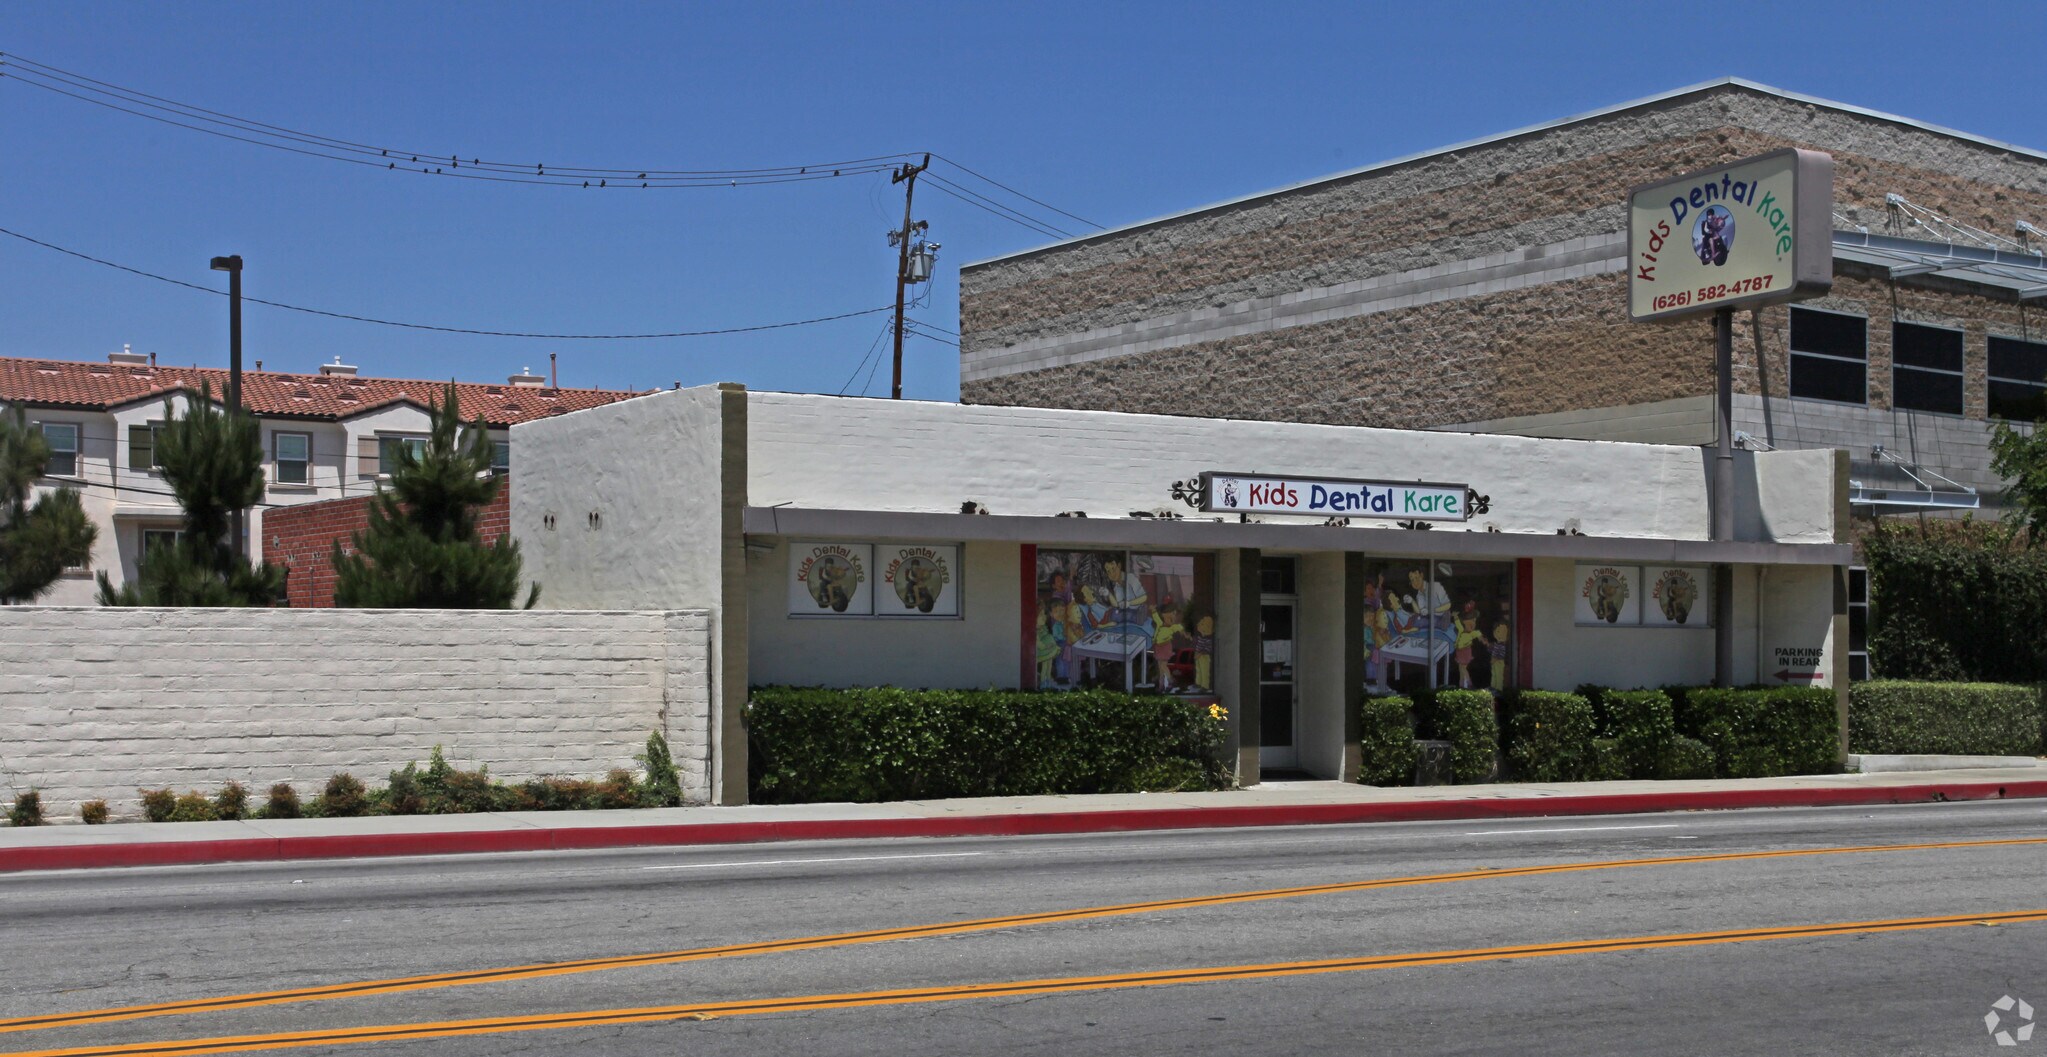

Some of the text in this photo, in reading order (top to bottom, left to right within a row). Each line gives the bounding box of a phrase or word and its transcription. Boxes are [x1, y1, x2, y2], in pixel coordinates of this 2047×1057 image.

[1637, 173, 1792, 281] Kids Dental Kare
[1653, 274, 1774, 311] (626) 582-4787
[1249, 482, 1299, 508] Kids
[1308, 484, 1394, 512] Dental
[1404, 489, 1458, 514] Kare
[797, 545, 865, 583] Kids Dental Kare
[884, 547, 951, 584] Kids Dental Kare
[1582, 577, 1595, 598] Kids
[1593, 567, 1620, 578] Dental
[1652, 578, 1665, 599] Kids
[1662, 568, 1690, 579] Dental
[1775, 647, 1824, 657] PARKING
[1779, 657, 1820, 667] IN REAR
